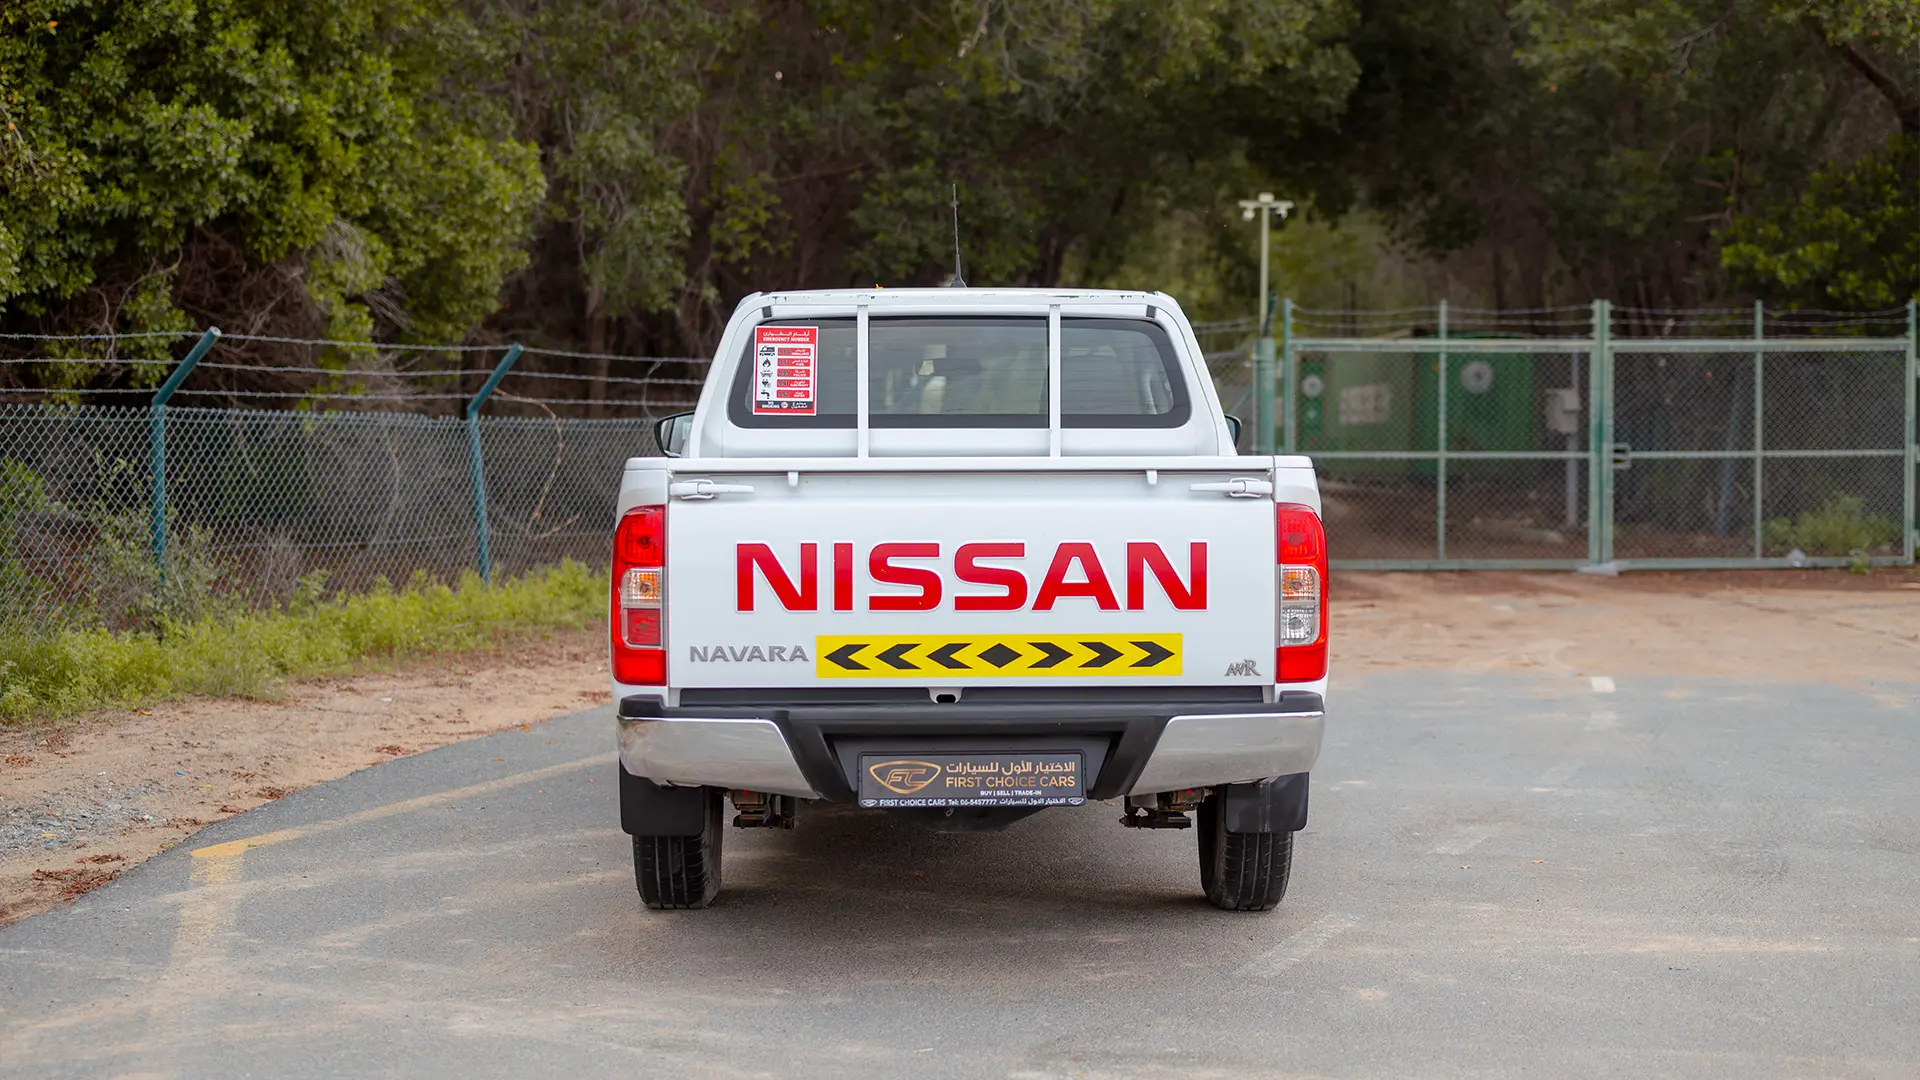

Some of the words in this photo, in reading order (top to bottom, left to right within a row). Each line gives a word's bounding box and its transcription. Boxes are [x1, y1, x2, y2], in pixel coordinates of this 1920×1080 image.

[735, 541, 1209, 612] NISSAN
[689, 645, 809, 662] NAVARA
[946, 761, 999, 775] للسيارات
[1001, 760, 1032, 776] الأول
[1035, 761, 1076, 775] الاختيار
[945, 776, 982, 788] FIRST
[985, 776, 1037, 788] CHOICE
[1039, 776, 1076, 788] CARS
